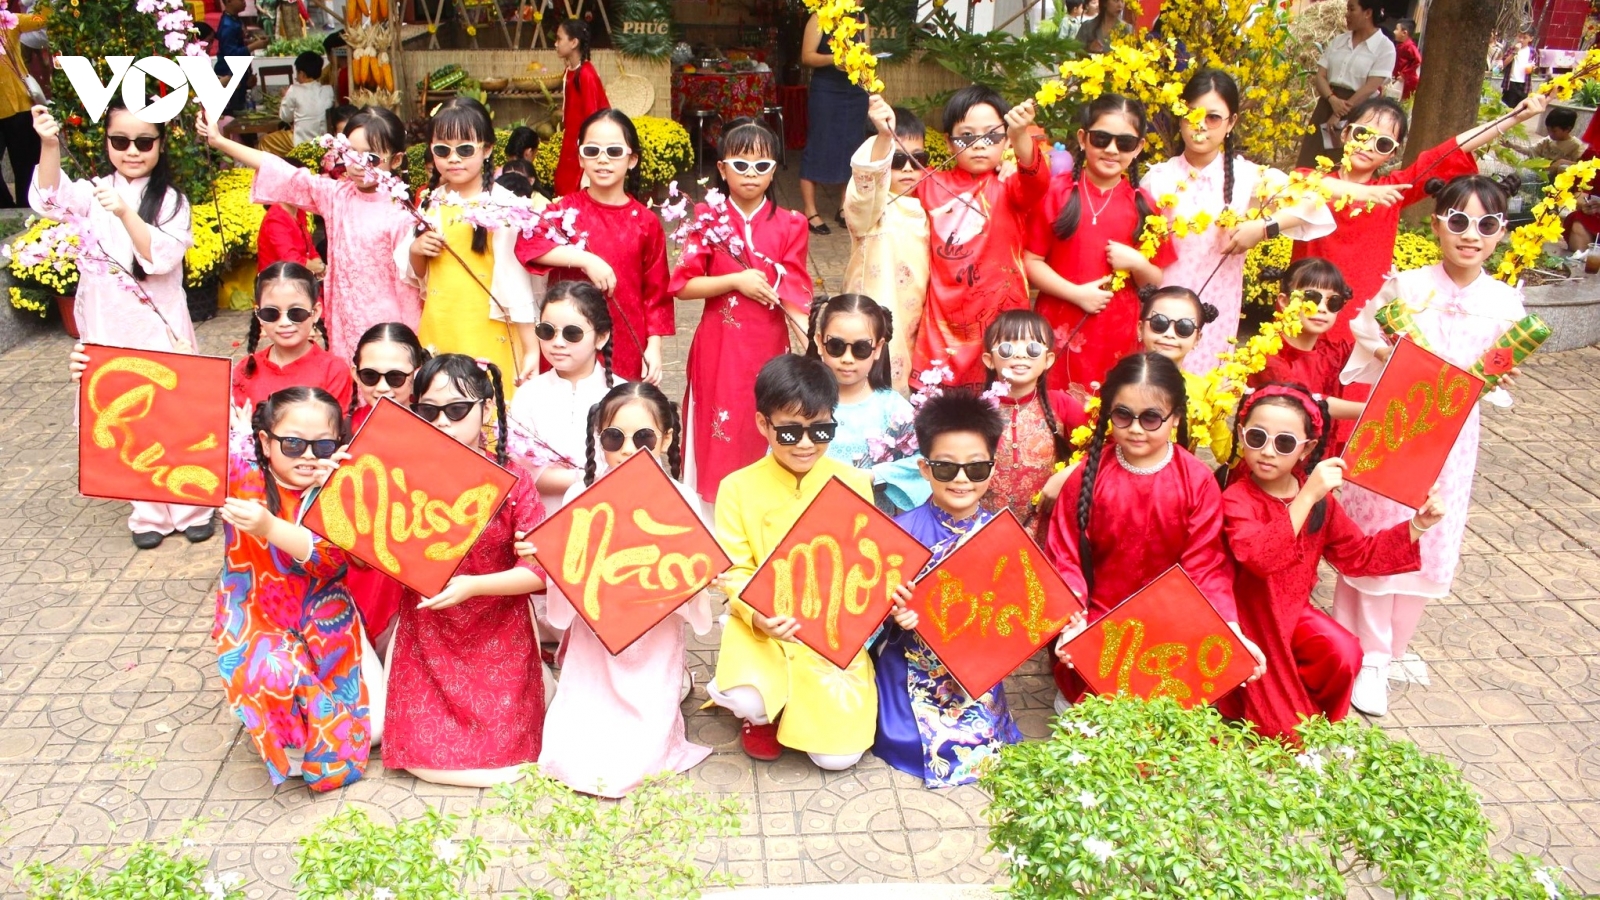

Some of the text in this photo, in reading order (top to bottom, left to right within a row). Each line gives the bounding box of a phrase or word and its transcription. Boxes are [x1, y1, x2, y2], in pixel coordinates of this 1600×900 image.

[1349, 364, 1470, 477] 2026
[319, 453, 499, 574] Mừng
[772, 513, 904, 651] Mới
[926, 548, 1071, 645] Bính
[1098, 618, 1233, 700] Ngọ
